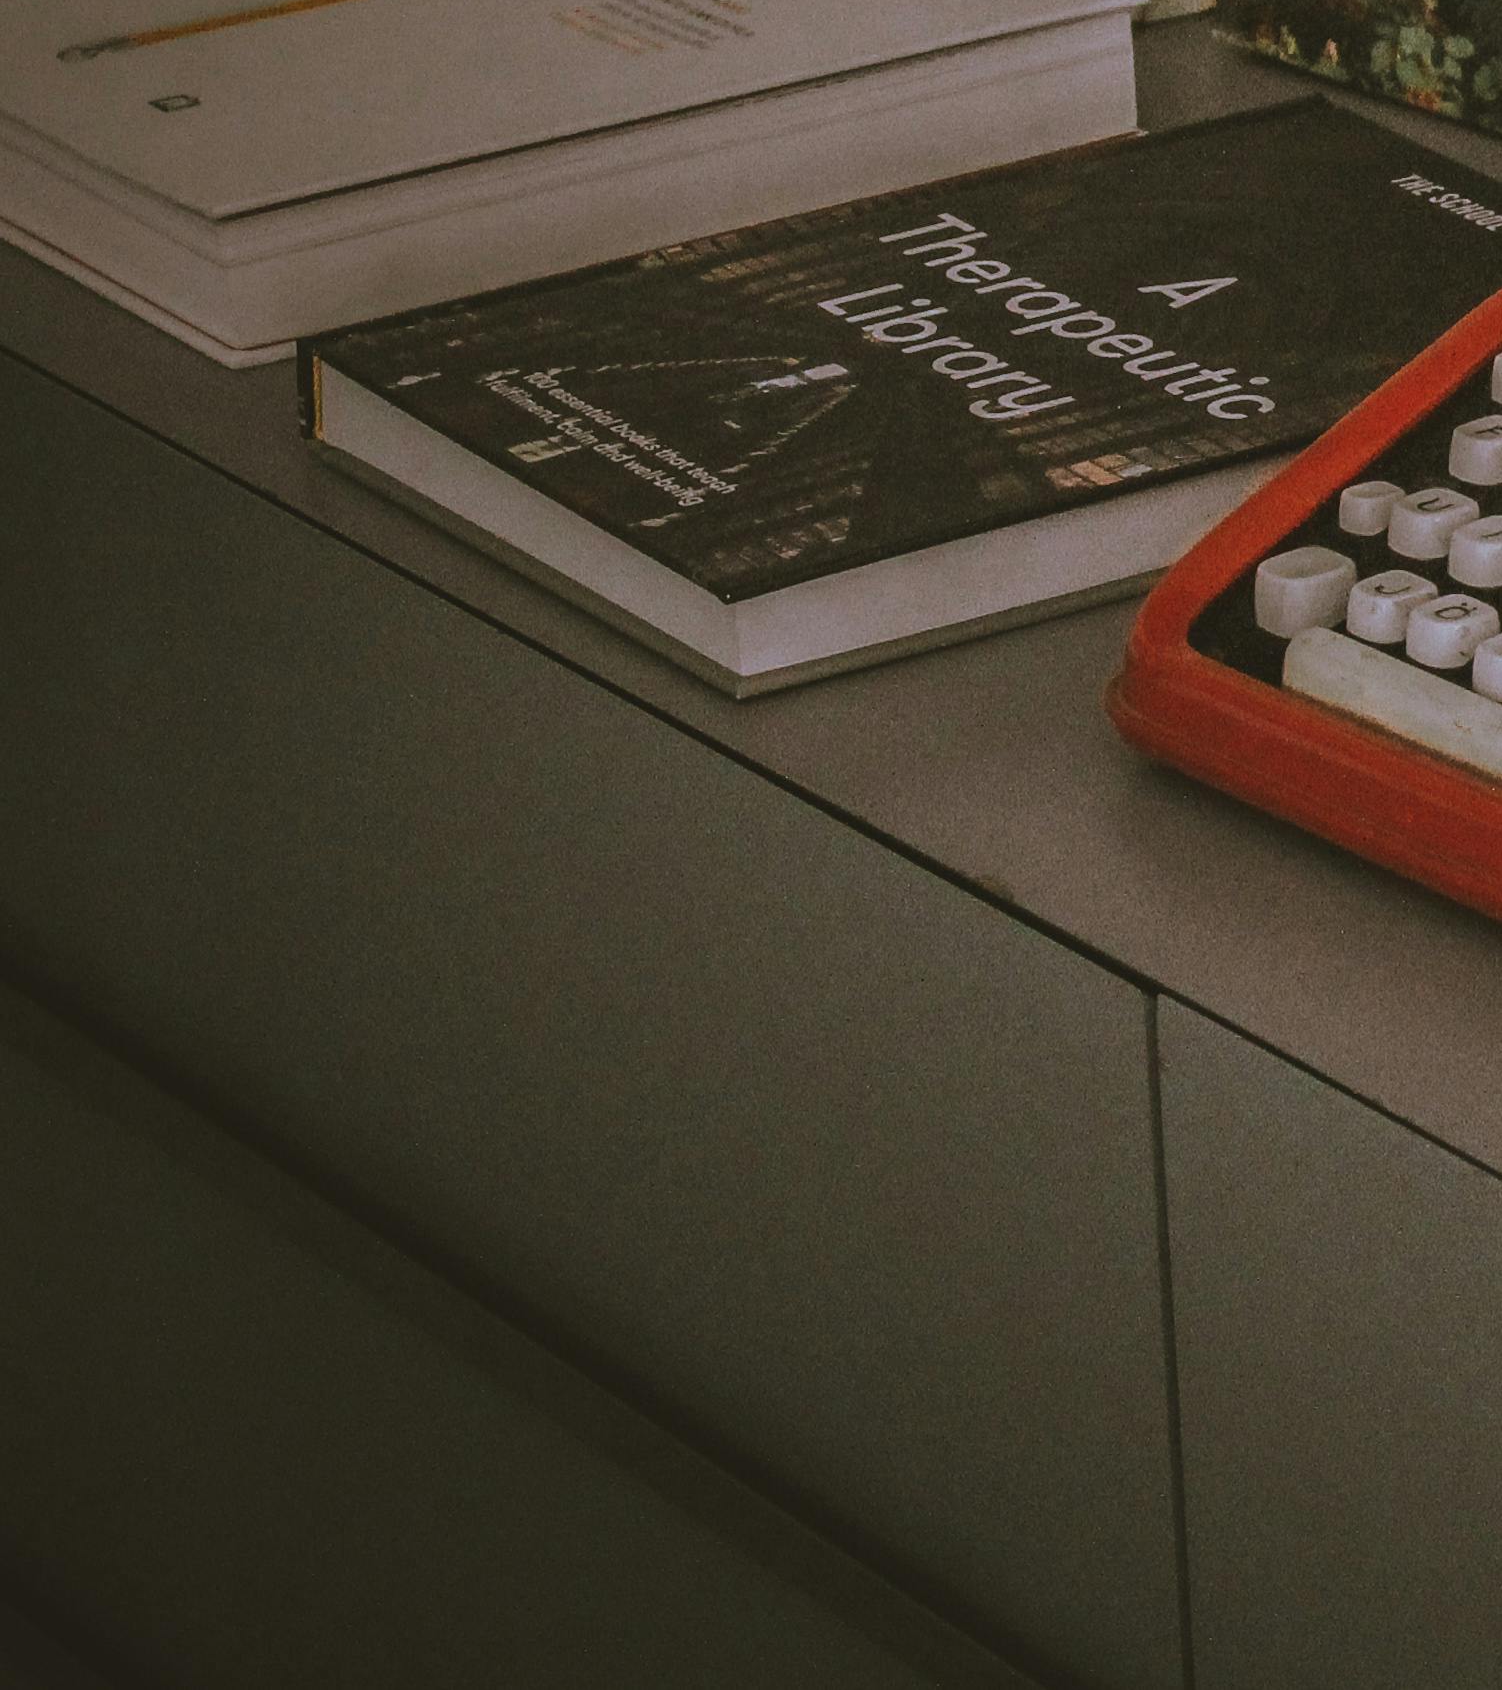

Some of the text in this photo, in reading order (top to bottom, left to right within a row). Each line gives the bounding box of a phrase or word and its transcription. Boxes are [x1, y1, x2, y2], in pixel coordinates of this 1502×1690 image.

[1390, 173, 1445, 197] THE
[878, 213, 1277, 421] Therapeutic
[1137, 275, 1239, 310] A
[817, 283, 1076, 420] Library
[523, 371, 740, 495] 100 essential books that teach
[556, 417, 600, 447] calm
[593, 441, 636, 464] and
[623, 459, 706, 508] well-being
